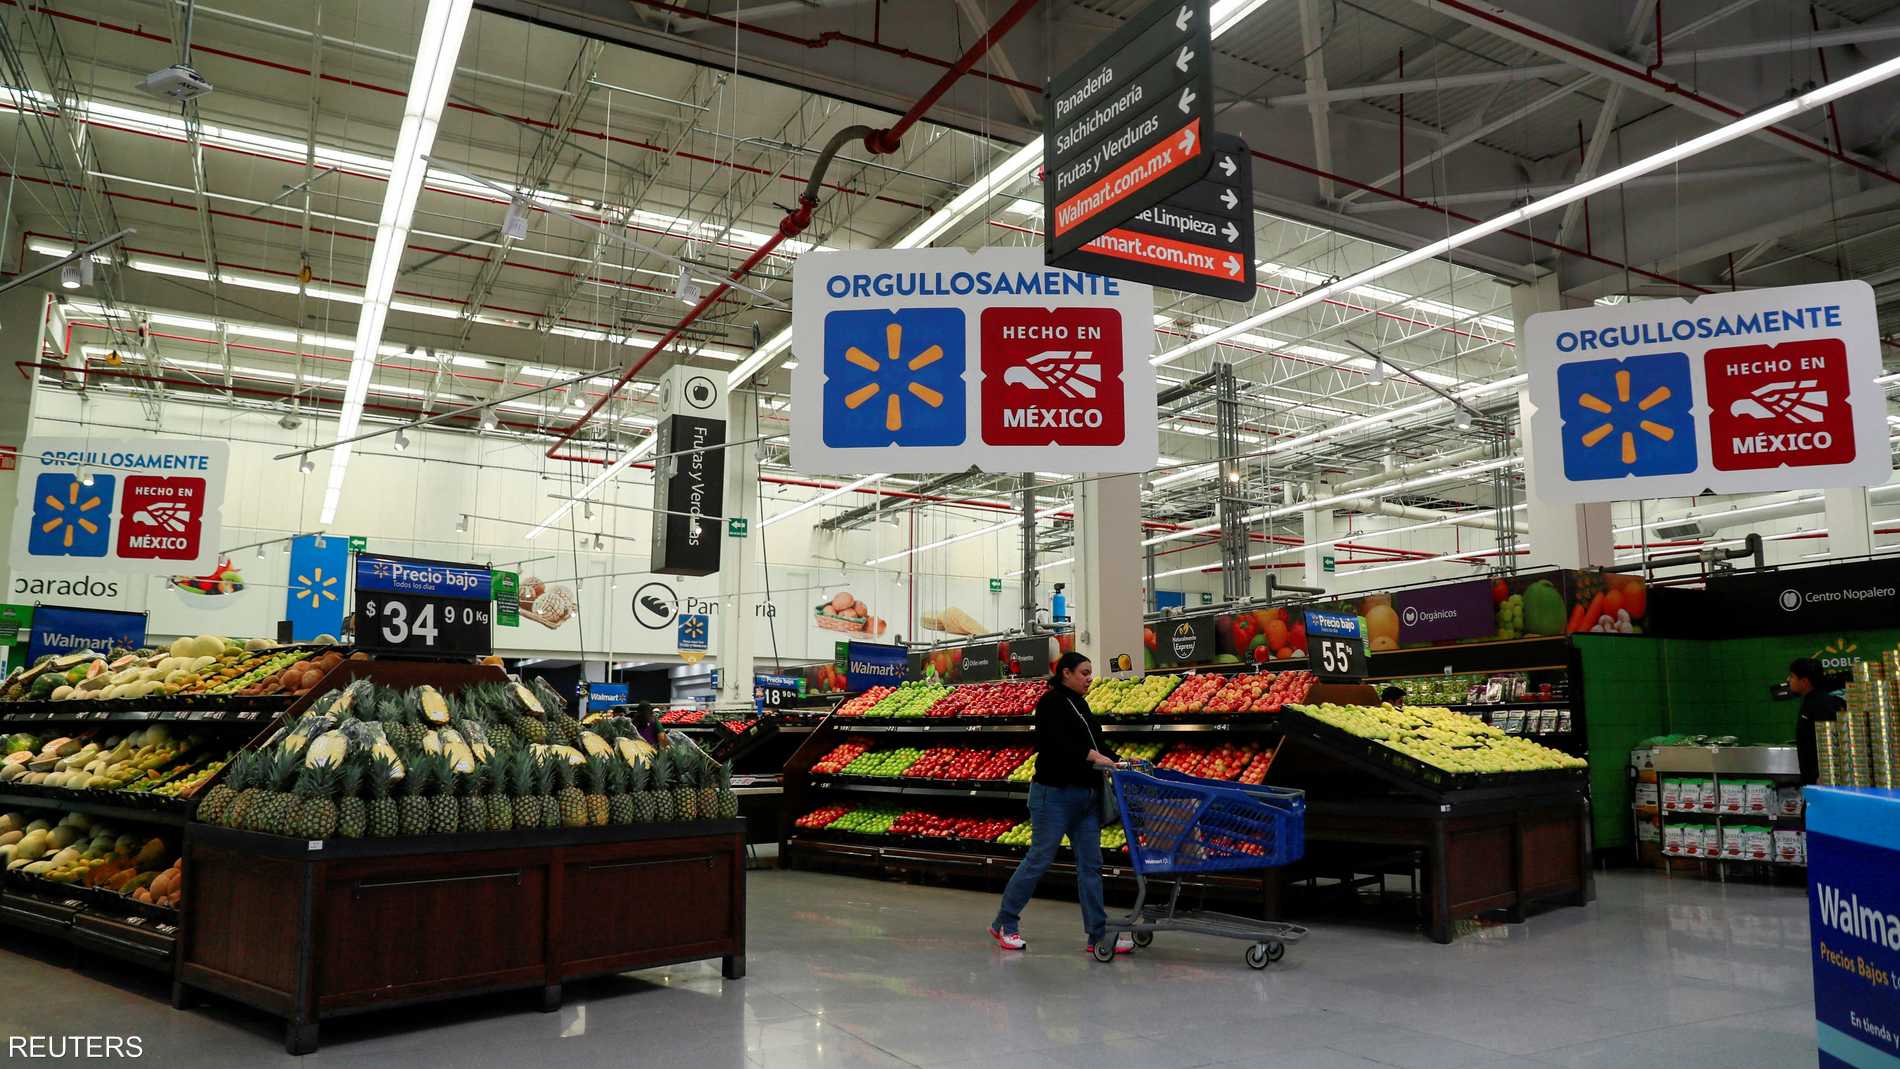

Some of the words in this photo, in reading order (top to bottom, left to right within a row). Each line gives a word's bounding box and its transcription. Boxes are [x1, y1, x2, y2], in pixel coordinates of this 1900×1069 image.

[1056, 66, 1113, 119] Panadería
[1056, 84, 1143, 154] Salchichonería
[1057, 156, 1092, 191] Frutas
[1093, 149, 1101, 173] y
[1101, 113, 1159, 158] Verduras
[1058, 147, 1172, 227] Walmart.com.mx
[1154, 208, 1217, 236] Limpieza
[826, 271, 1120, 298] ORGULLOSAMENTE
[1003, 325, 1068, 340] HECHO
[1078, 326, 1101, 339] EN
[1556, 305, 1842, 352] ORGULLOSAMENTE
[1726, 359, 1792, 377] HECHO
[1800, 356, 1826, 370] EN
[1003, 407, 1102, 428] MÉXICO
[690, 426, 707, 476] Frutas
[1732, 431, 1832, 455] MÉXICO
[688, 472, 704, 485] y
[135, 486, 174, 497] HECHO
[178, 488, 193, 497] EN
[129, 534, 188, 550] MÉXICO
[392, 564, 442, 583] Precio
[446, 570, 478, 591] bajo
[1805, 592, 1841, 603] Centro
[1843, 587, 1896, 601] Nopalero
[365, 601, 377, 618] $
[382, 601, 439, 646] 34
[476, 611, 488, 624] Kg
[1319, 614, 1340, 629] Precio
[1340, 618, 1355, 632] bajo
[42, 632, 115, 650] Walmart
[1175, 643, 1194, 651] Express
[850, 661, 895, 677] Walmart
[1322, 641, 1348, 673] 55
[591, 693, 618, 701] Walmart
[765, 688, 781, 705] 18
[1820, 941, 1855, 972] Precios
[1857, 955, 1889, 986] Bajos
[1850, 1011, 1862, 1029] En
[1863, 1017, 1892, 1042] tienda
